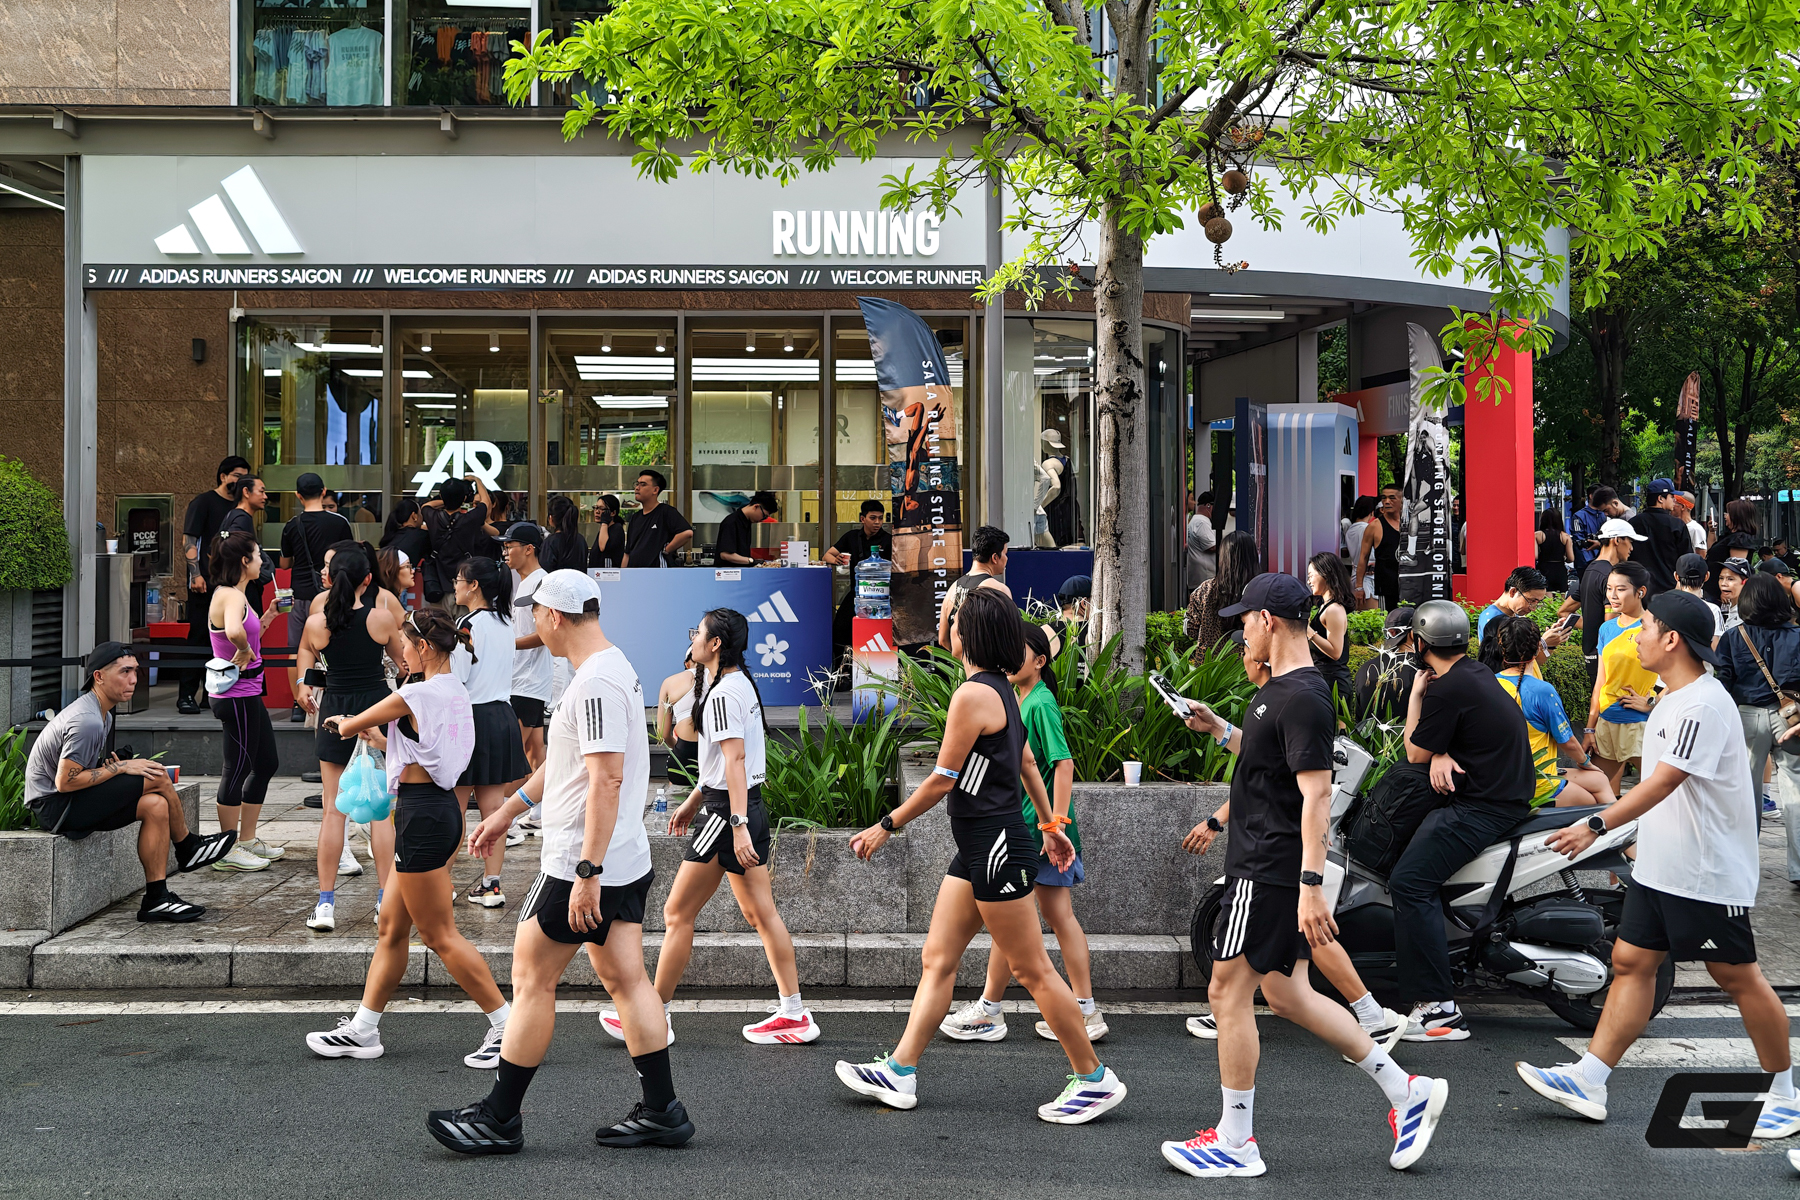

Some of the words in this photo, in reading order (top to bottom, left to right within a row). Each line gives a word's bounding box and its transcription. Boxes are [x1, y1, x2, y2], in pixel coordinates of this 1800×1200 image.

[773, 211, 940, 255] RUNNING
[139, 269, 199, 283] ADIDAS
[203, 269, 278, 283] RUNNERS
[281, 269, 341, 283] SAIGON
[384, 269, 467, 283] WELCOME
[471, 269, 546, 283] RUNNERS
[587, 269, 646, 283] ADIDAS
[650, 269, 725, 284] RUNNERS
[728, 269, 789, 284] SAIGON
[831, 270, 914, 284] WELCOME
[917, 270, 981, 284] RUNNER
[922, 360, 937, 400] SALA
[928, 410, 942, 486] RUNNING
[931, 495, 946, 547] STORE
[1433, 499, 1444, 545] STORE
